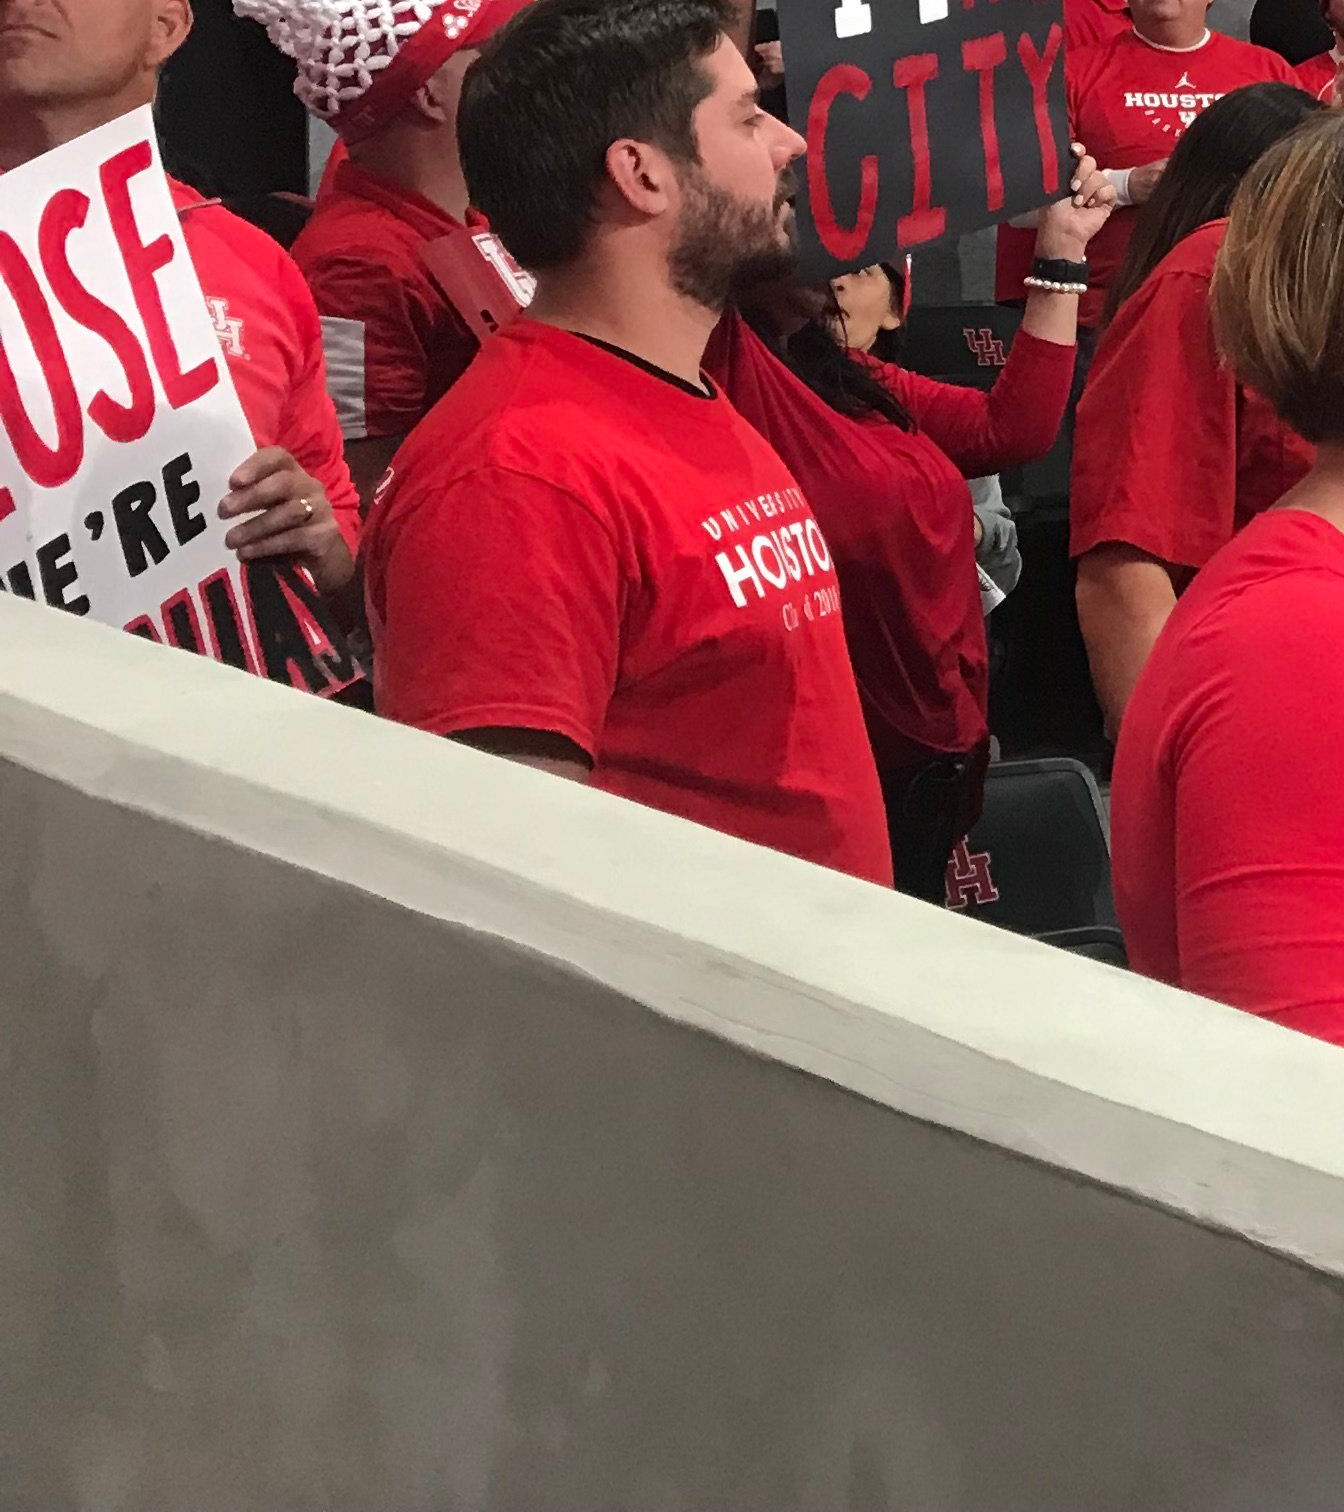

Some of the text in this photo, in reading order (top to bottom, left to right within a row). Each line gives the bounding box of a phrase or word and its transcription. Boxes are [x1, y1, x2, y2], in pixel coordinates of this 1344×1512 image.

[806, 21, 1064, 262] CITY
[1124, 91, 1227, 109] HOUST
[963, 328, 1007, 366] UH
[0, 452, 207, 618] E'RE
[714, 518, 835, 608] HOSTO
